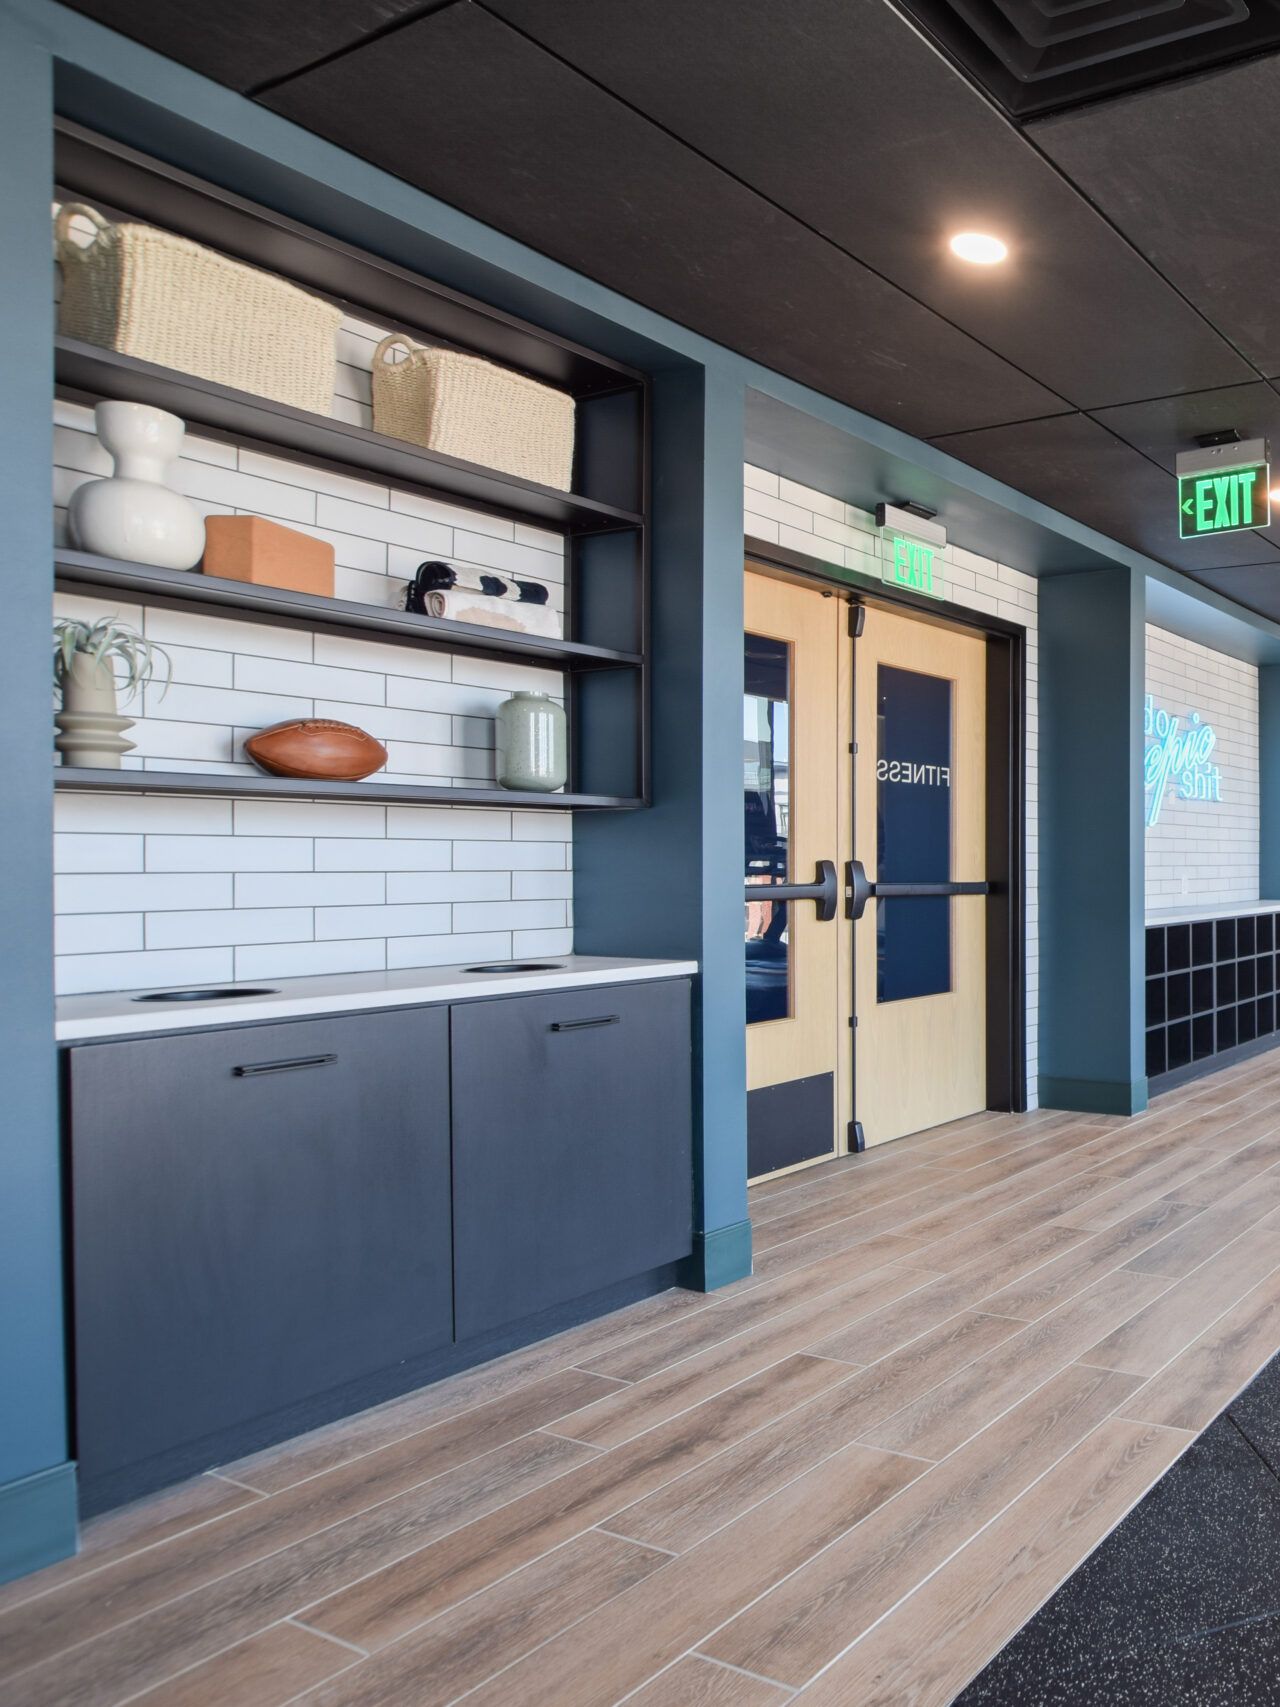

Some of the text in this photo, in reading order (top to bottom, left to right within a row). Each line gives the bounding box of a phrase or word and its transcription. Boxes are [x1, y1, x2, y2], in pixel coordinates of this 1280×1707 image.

[1196, 472, 1256, 531] EXIT
[893, 537, 935, 592] EXIT
[1179, 762, 1223, 801] shit
